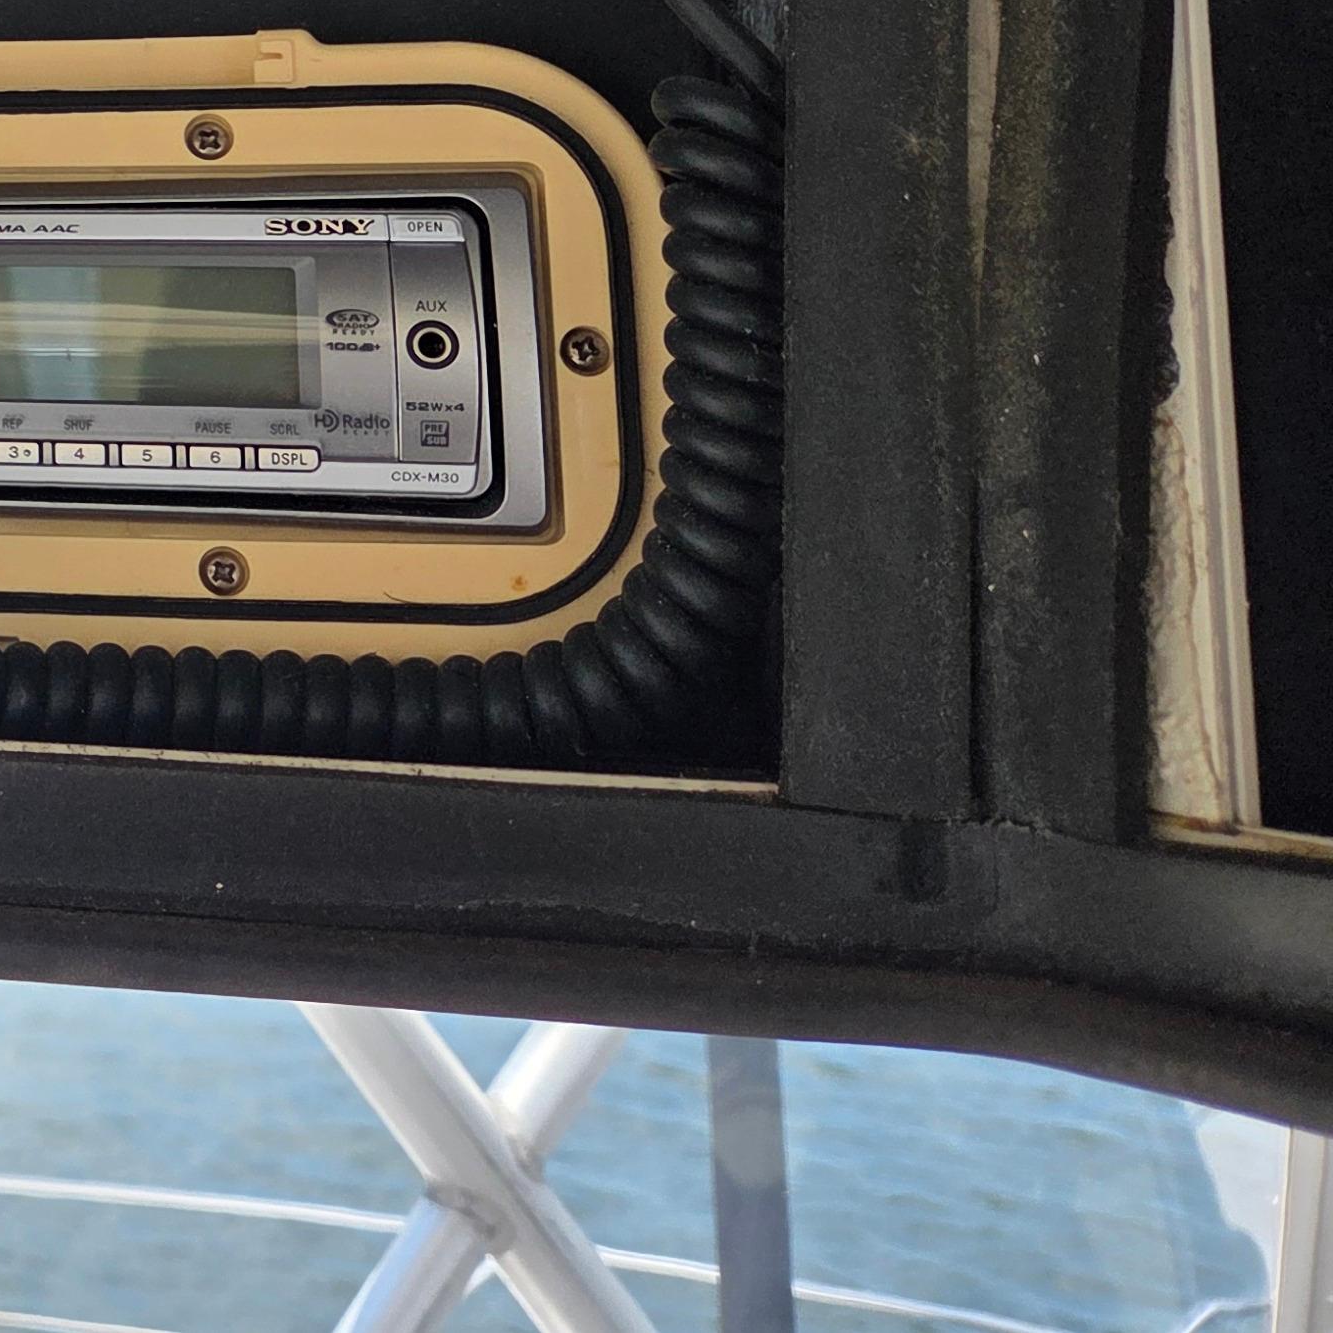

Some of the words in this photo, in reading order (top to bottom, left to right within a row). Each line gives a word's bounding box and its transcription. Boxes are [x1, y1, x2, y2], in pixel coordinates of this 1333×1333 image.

[33, 224, 80, 234] AAC
[264, 217, 375, 236] SONY
[407, 221, 443, 233] OPEN
[415, 300, 447, 313] AUX
[336, 312, 371, 323] SAT
[332, 328, 375, 336] READY
[405, 401, 466, 413] 52Wx4
[2, 418, 24, 430] REP
[63, 418, 94, 431] SHUF
[194, 421, 232, 434] PAUSE
[314, 409, 340, 433] HD
[342, 414, 391, 430] Radio
[269, 423, 300, 436] SCRL
[424, 423, 444, 434] PRE
[8, 446, 19, 459] 3
[73, 447, 85, 460] 4
[142, 449, 153, 462] 5
[210, 450, 222, 464] 6
[271, 452, 308, 466] DSPL
[391, 471, 460, 484] CDX-M30
